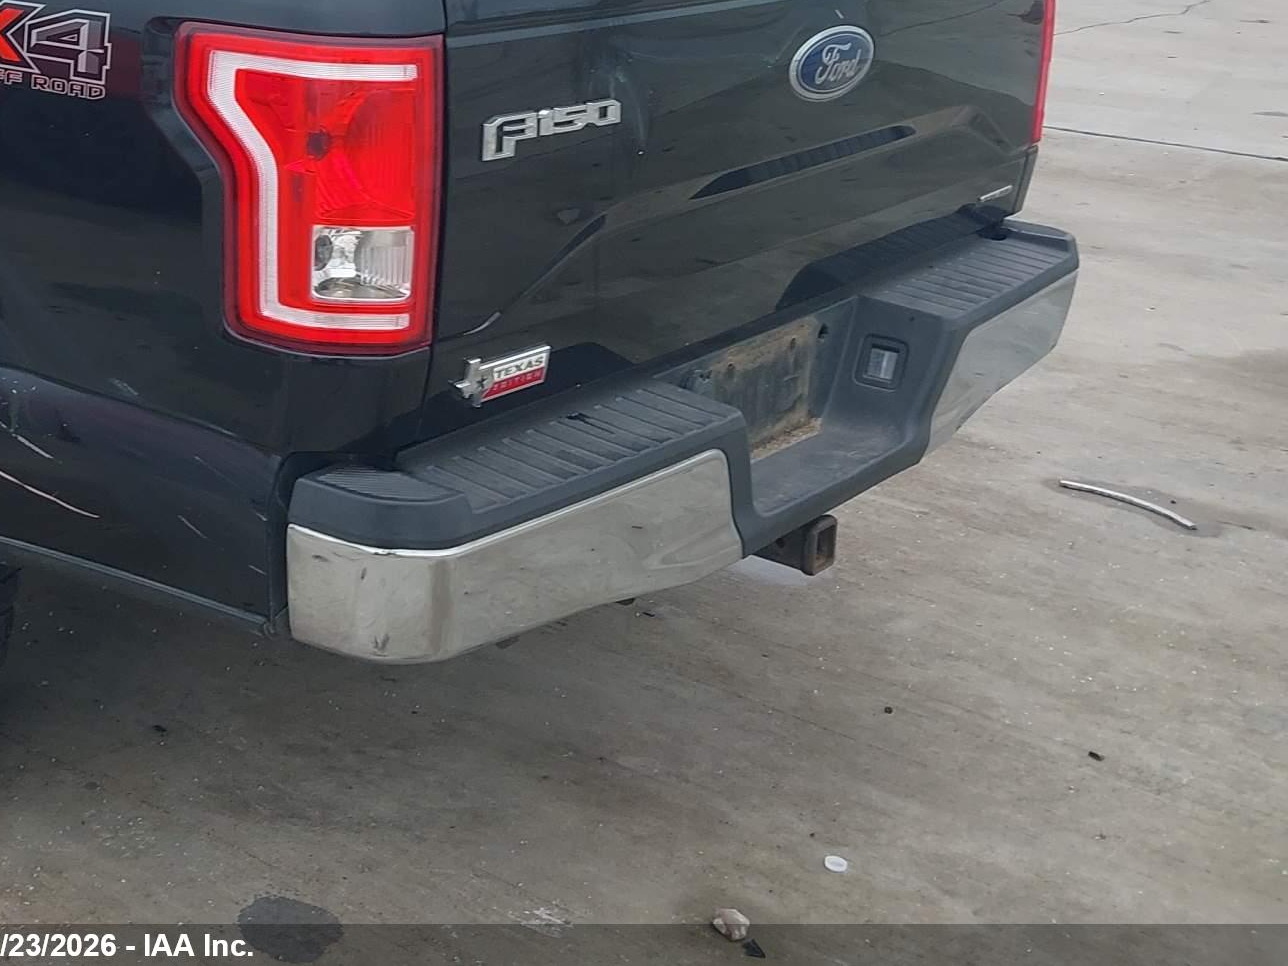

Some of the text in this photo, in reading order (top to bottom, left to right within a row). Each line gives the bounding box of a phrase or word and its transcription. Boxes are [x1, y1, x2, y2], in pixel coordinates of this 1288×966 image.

[814, 42, 861, 84] Ford
[31, 73, 106, 100] ROAD
[495, 356, 544, 379] TEXAS
